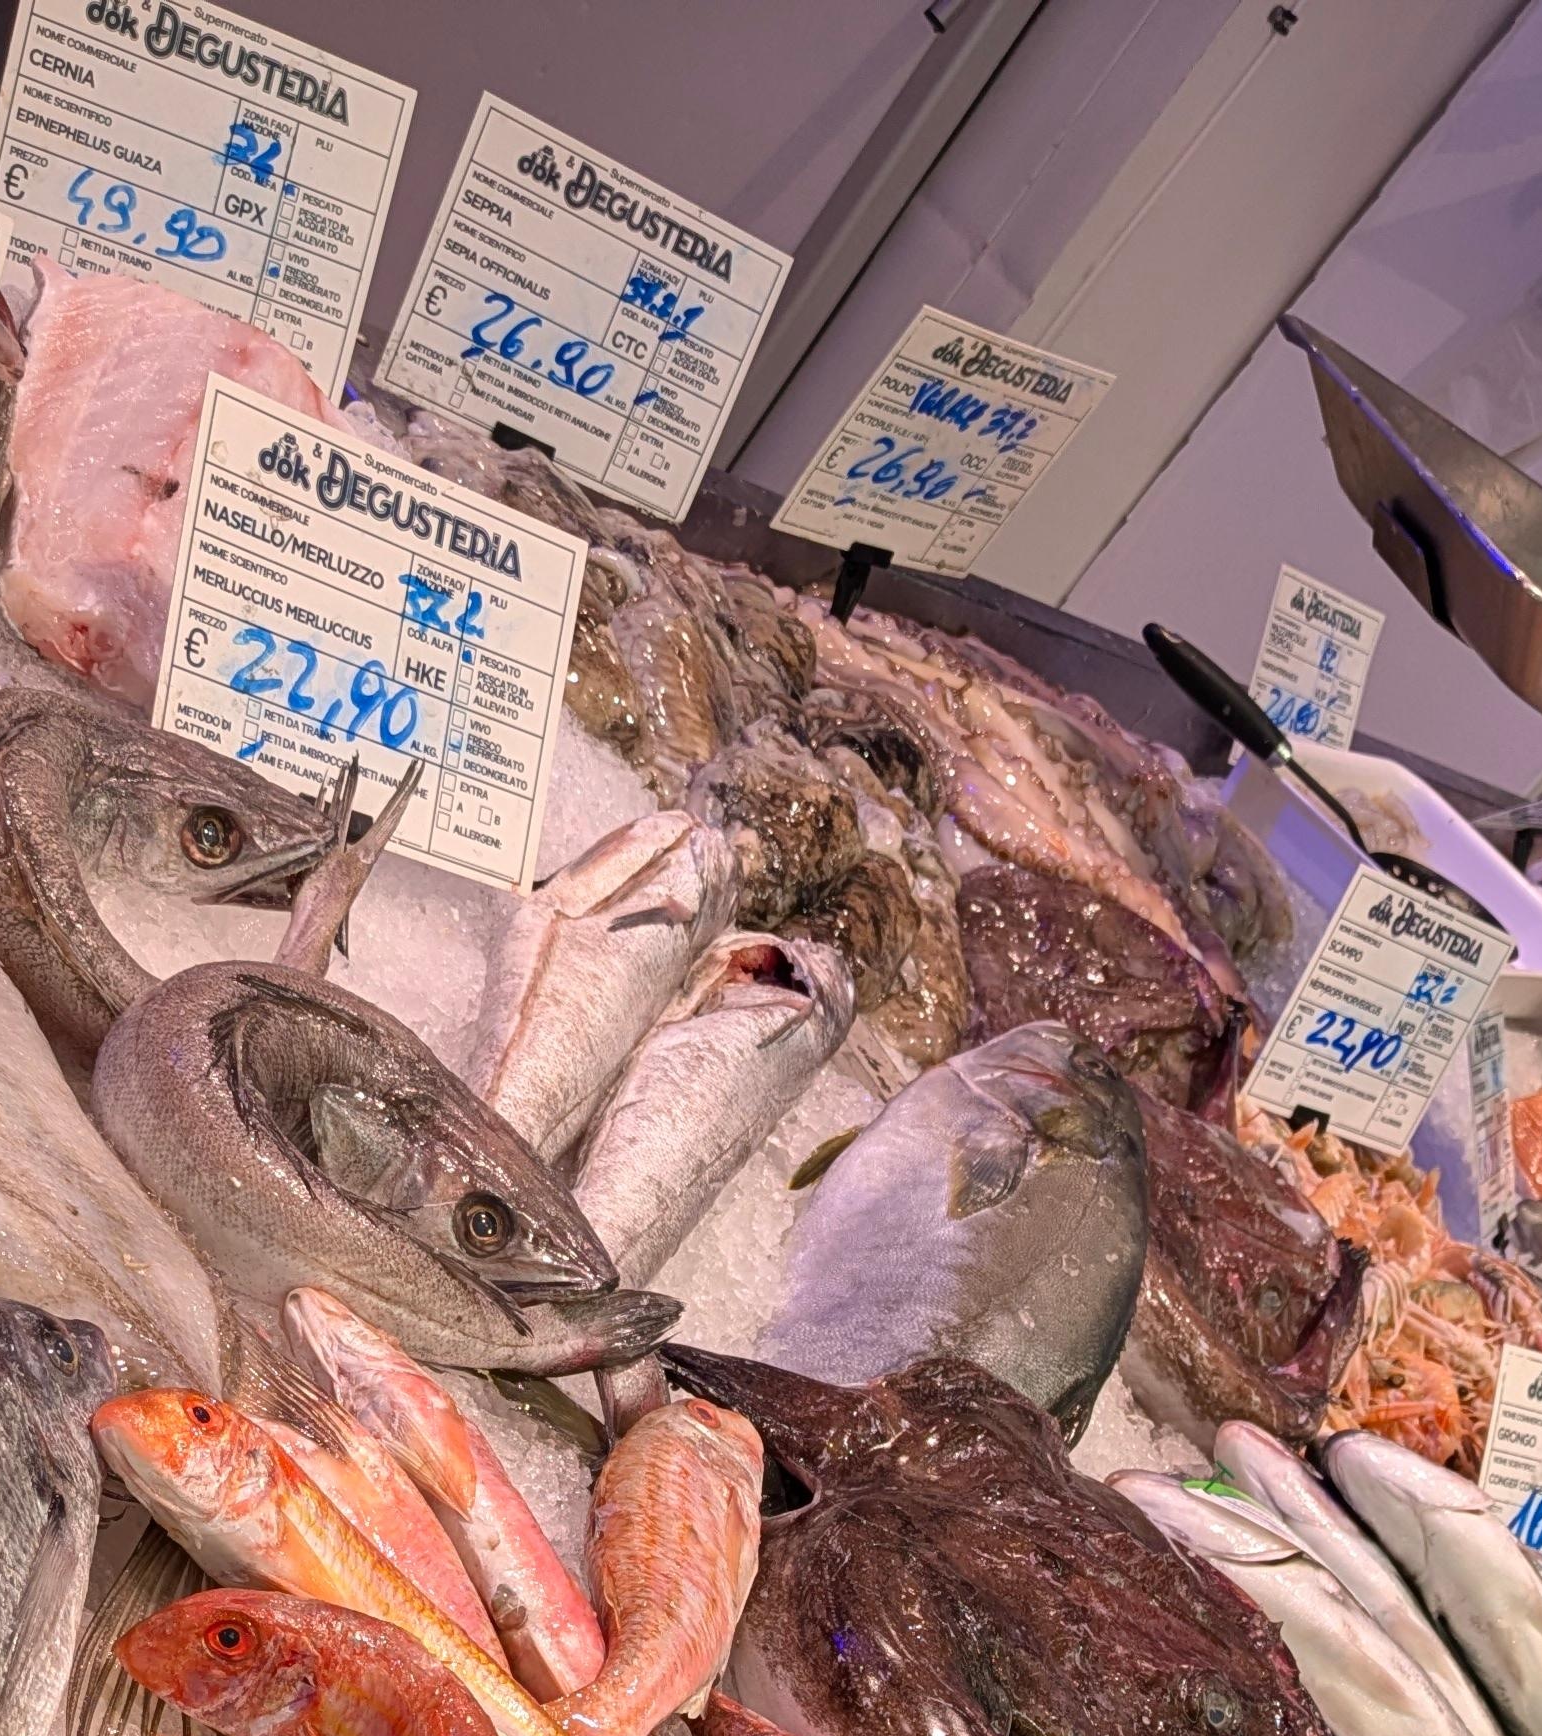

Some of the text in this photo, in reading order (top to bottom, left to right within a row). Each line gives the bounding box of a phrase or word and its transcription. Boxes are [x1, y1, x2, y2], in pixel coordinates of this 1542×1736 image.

[193, 6, 267, 47] Supermercato
[28, 48, 96, 89] CERNIA
[9, 145, 49, 168] PREZZO
[15, 108, 163, 175] EPINEPHELUS GUAZA
[315, 137, 334, 153] PLU
[4, 163, 29, 201] €
[517, 153, 561, 193] dok
[609, 167, 671, 208] Supermercato
[224, 193, 266, 227] GPX
[462, 189, 512, 228] SEPPIA
[444, 238, 551, 301] SEPIA OFFICINALIS
[425, 285, 448, 318] €
[611, 330, 648, 360] CTC
[880, 375, 916, 397] POLPO
[855, 413, 895, 435] OCTOPUS
[258, 443, 311, 492] dok
[312, 443, 323, 459] &
[364, 454, 438, 497] Supermercato
[825, 446, 845, 469] €
[210, 474, 311, 527] NOME COMMERCIALE
[203, 500, 385, 591] NASELLO/MERLUZZO
[188, 608, 228, 633] PREZZO
[193, 567, 373, 650] MERLUCCIUS MERLUCCIUS
[489, 594, 508, 611] PLU
[183, 628, 208, 669] €
[404, 655, 447, 693] HKE
[1327, 938, 1364, 964] SCAMPO
[1285, 1015, 1299, 1039] €
[1498, 1427, 1537, 1448] GRONGO
[1489, 1473, 1519, 1492] CONGER
